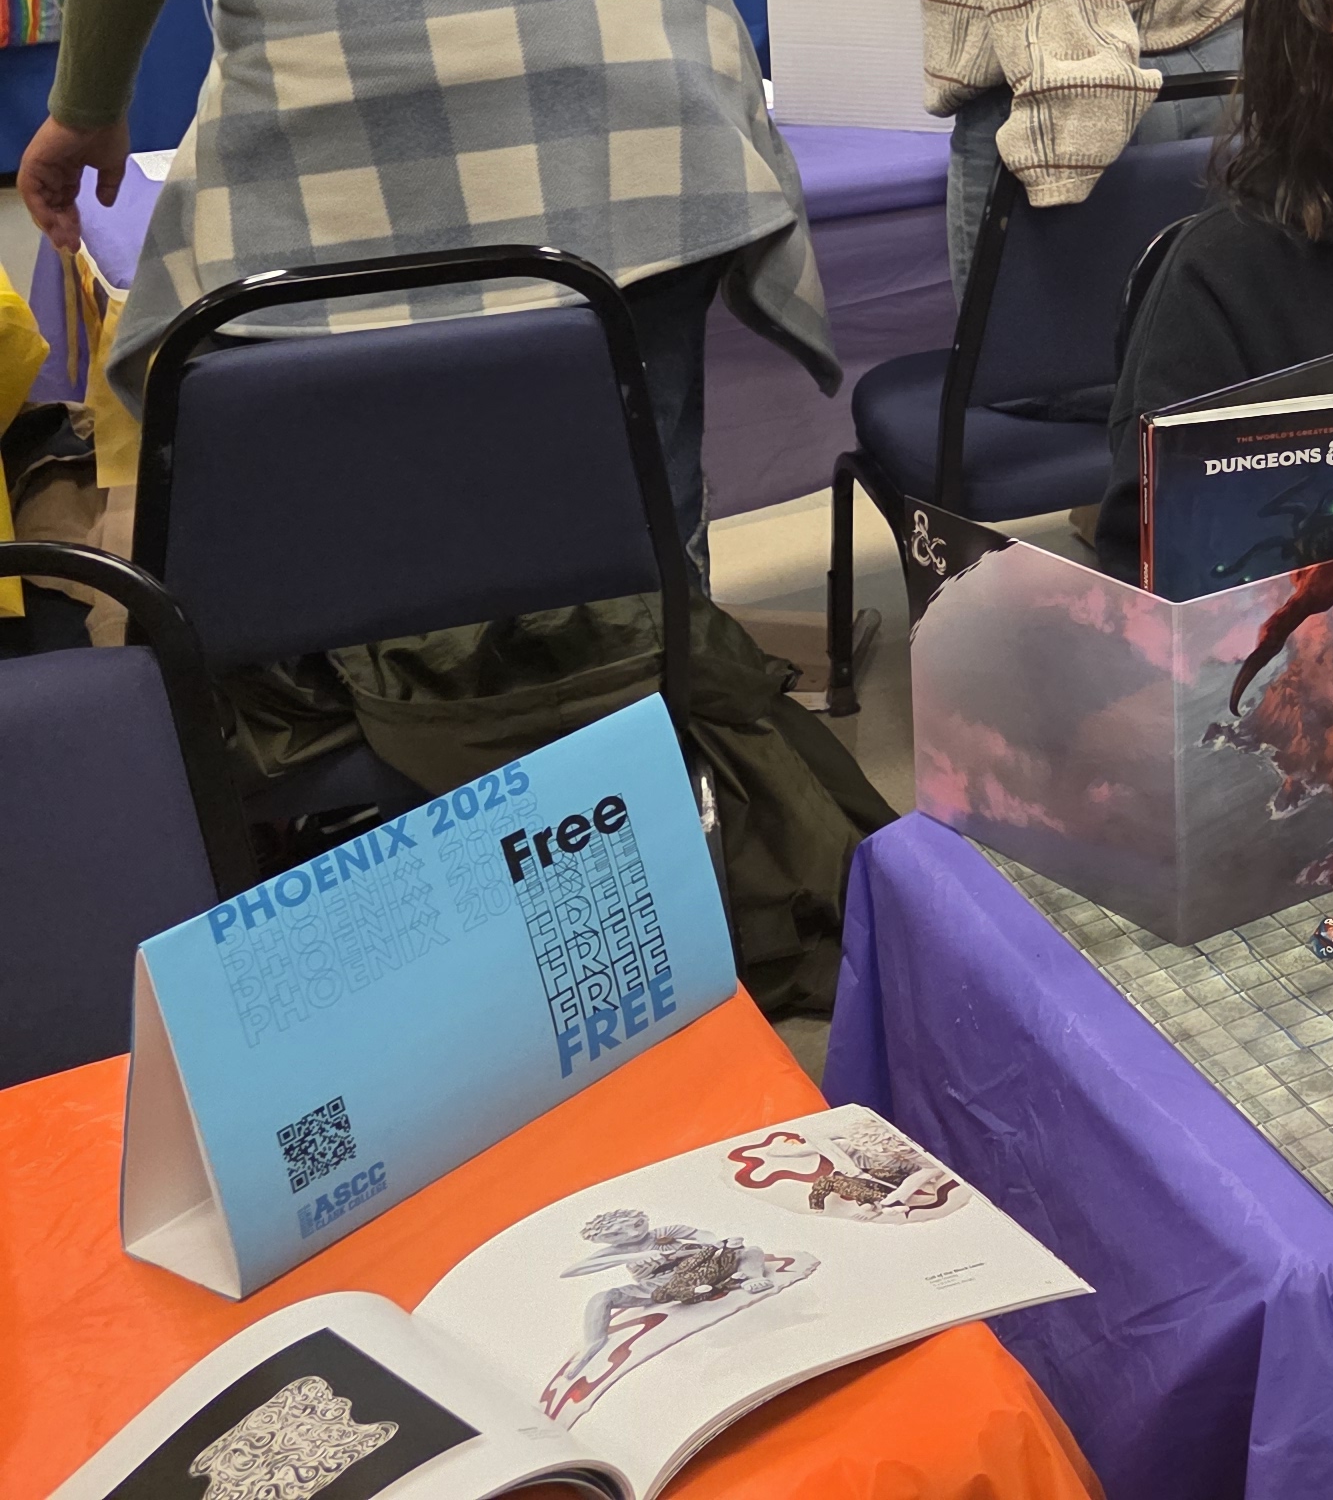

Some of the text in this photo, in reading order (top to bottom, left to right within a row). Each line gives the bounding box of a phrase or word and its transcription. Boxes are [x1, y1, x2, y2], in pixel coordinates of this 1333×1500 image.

[1204, 447, 1321, 476] DUNGEONS
[1255, 431, 1294, 441] WORLD'S
[207, 761, 530, 944] PHOENIX 2025
[500, 796, 628, 884] Free
[1320, 945, 1333, 956] 70
[557, 968, 677, 1079] FREE
[314, 1161, 386, 1221] ASCC
[316, 1207, 347, 1230] CLARK
[349, 1180, 388, 1211] COLLEGE
